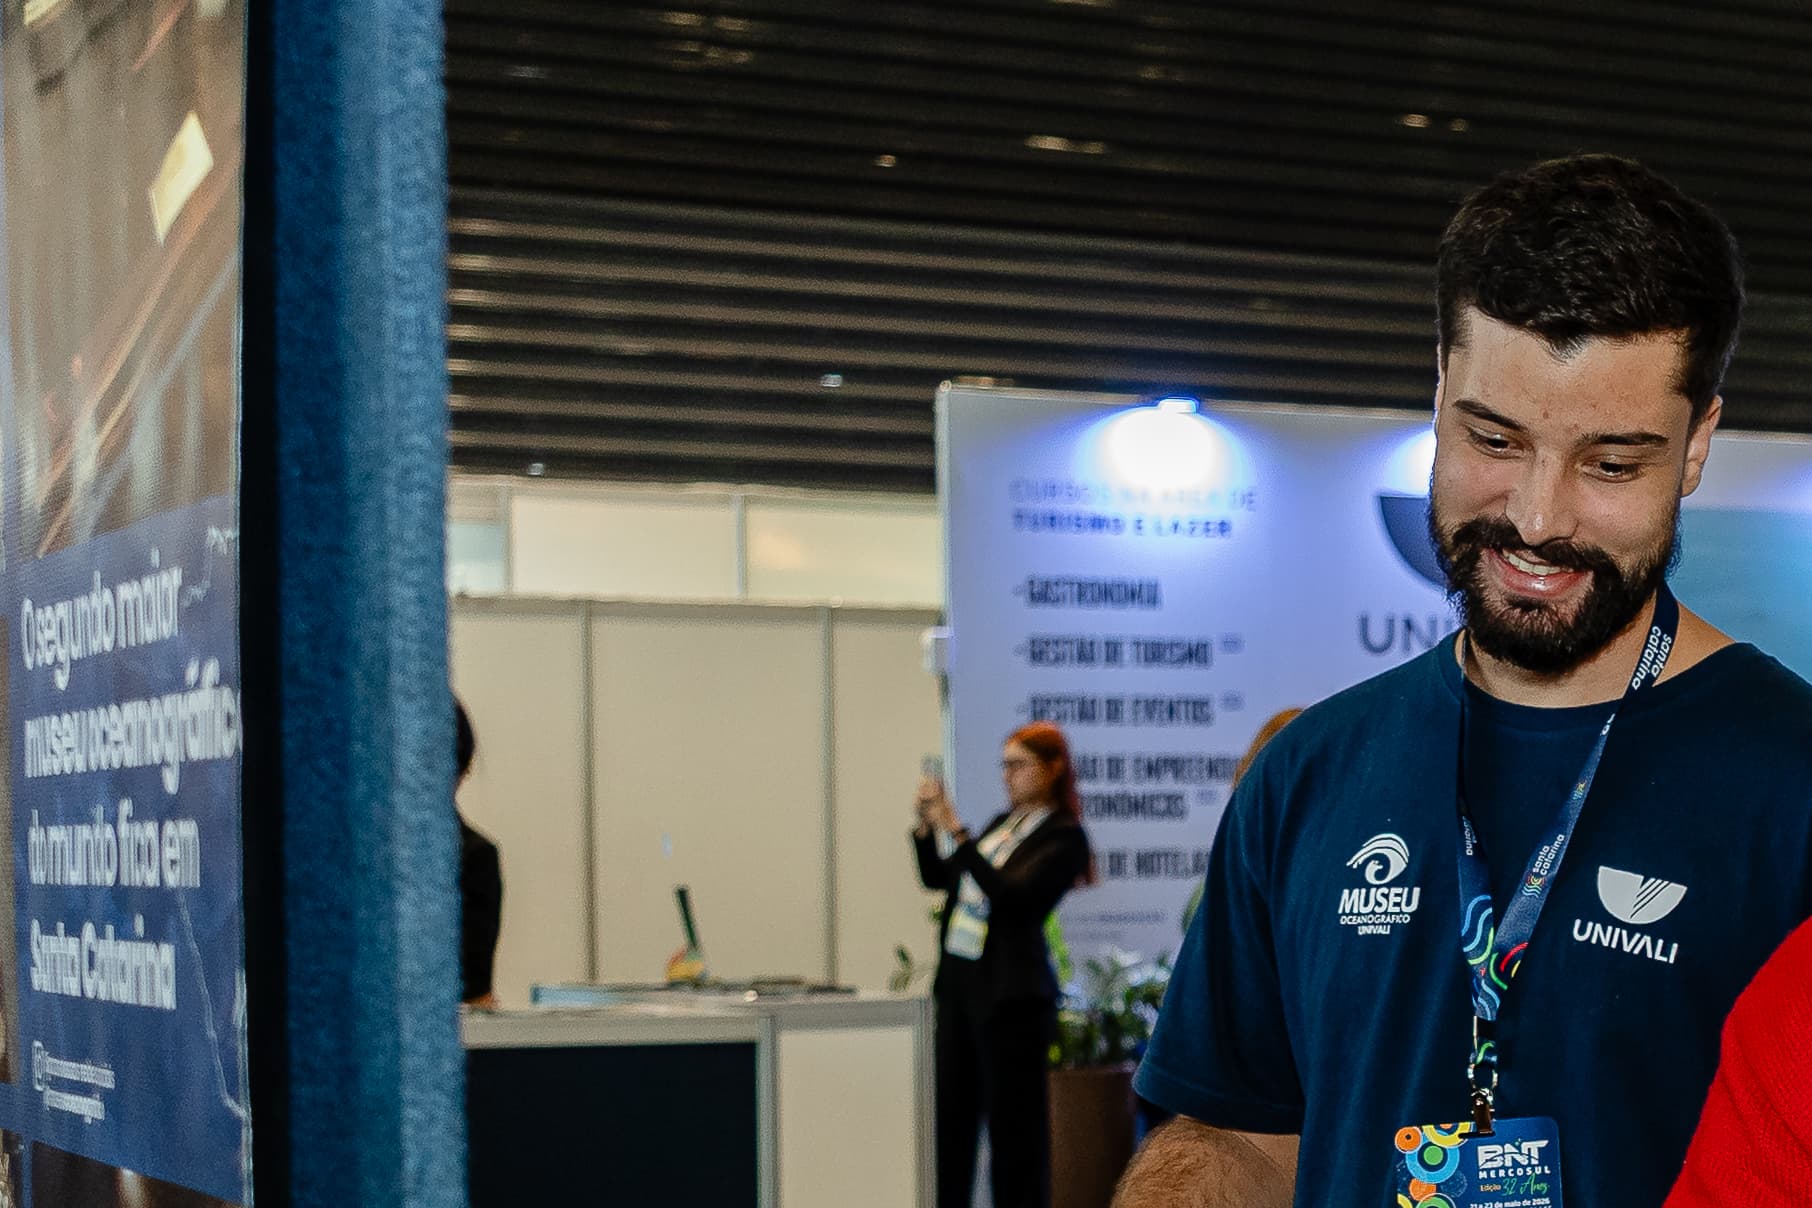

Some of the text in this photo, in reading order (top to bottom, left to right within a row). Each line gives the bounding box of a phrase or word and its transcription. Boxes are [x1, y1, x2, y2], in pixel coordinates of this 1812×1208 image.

[22, 548, 182, 691] O segundo maior
[1631, 625, 1661, 690] catarina
[1651, 633, 1672, 678] santa
[25, 711, 87, 777] museu
[29, 798, 200, 887] do mundo fica em
[1532, 845, 1550, 873] santa
[1540, 833, 1565, 875] catarina
[1338, 887, 1421, 914] MUSEU
[1358, 925, 1391, 936] UNIVALI
[1572, 918, 1679, 965] UNIVALI
[30, 912, 176, 1010] Santa Catarina
[1477, 1139, 1549, 1169] BNT
[1479, 1165, 1551, 1180] MERCOSUL
[1494, 1201, 1503, 1208] de
[1504, 1200, 1521, 1208] maio
[1522, 1198, 1531, 1207] de
